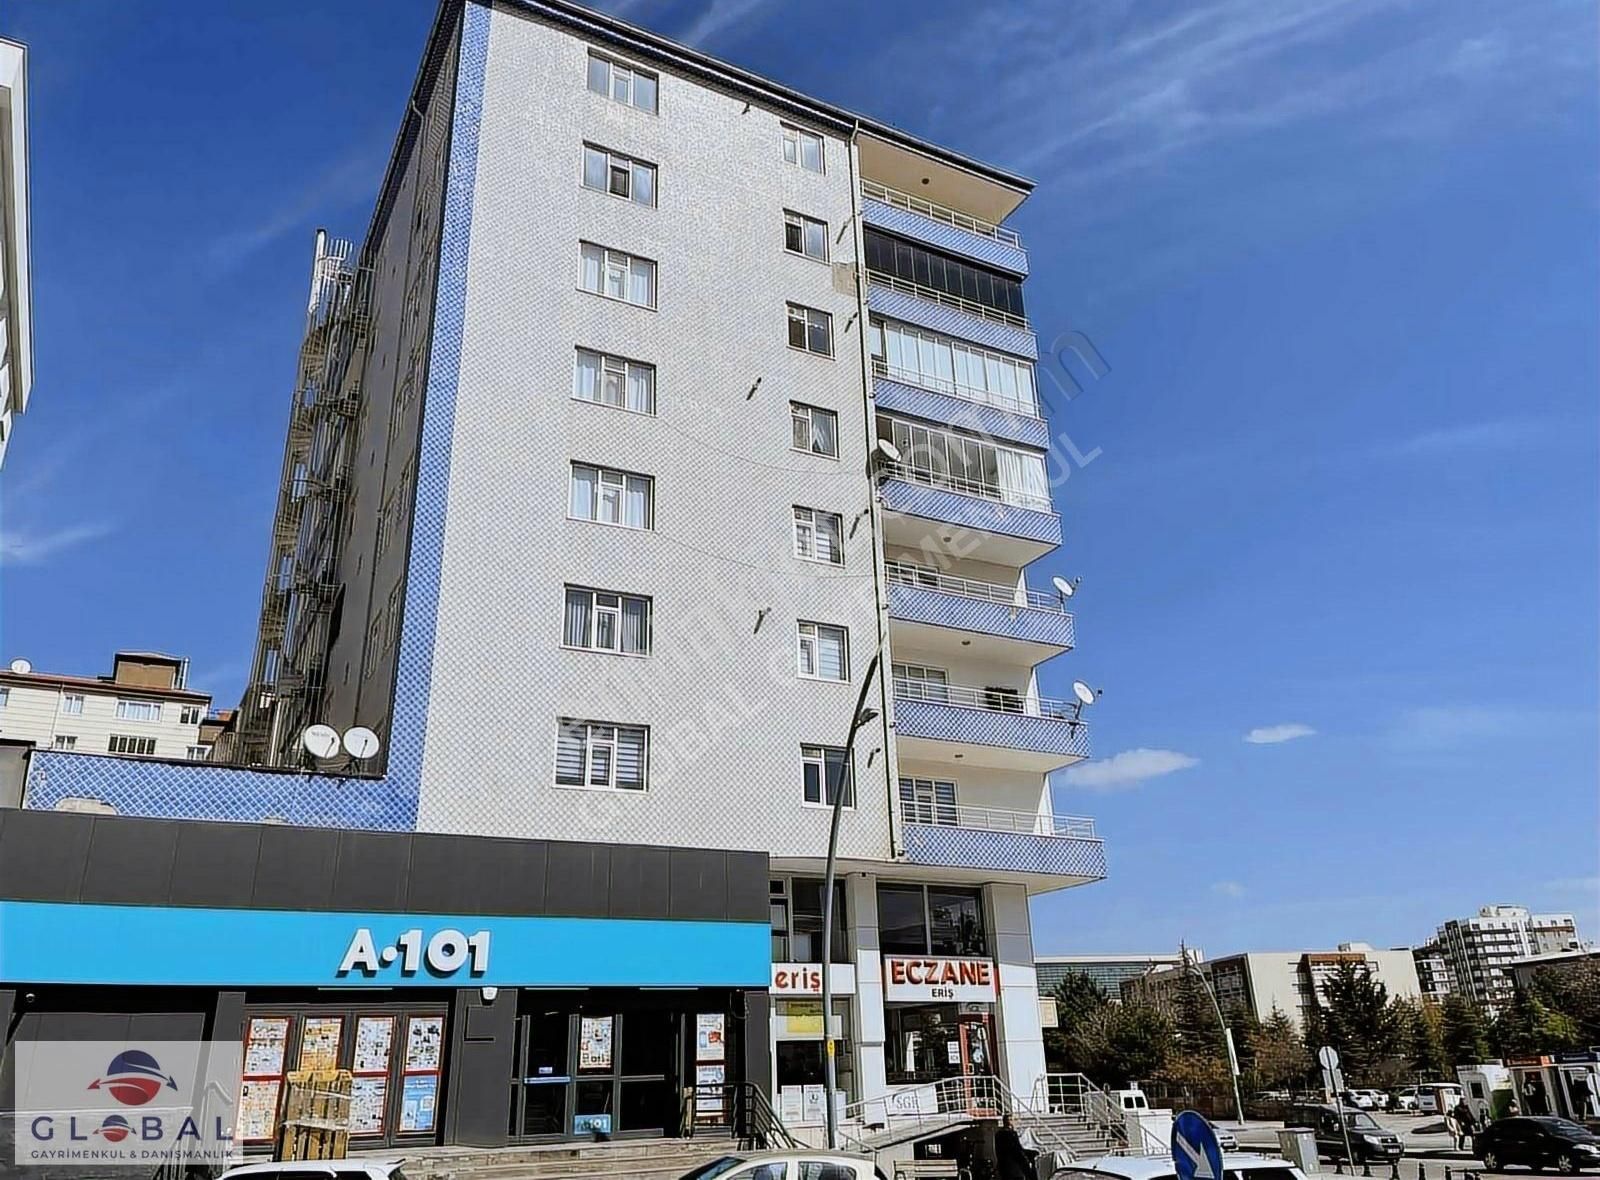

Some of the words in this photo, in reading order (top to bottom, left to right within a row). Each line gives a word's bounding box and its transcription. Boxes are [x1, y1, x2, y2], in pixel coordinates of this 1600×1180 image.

[775, 967, 821, 992] eriş
[891, 959, 990, 986] ECZANE
[931, 986, 954, 1000] ERİŞ
